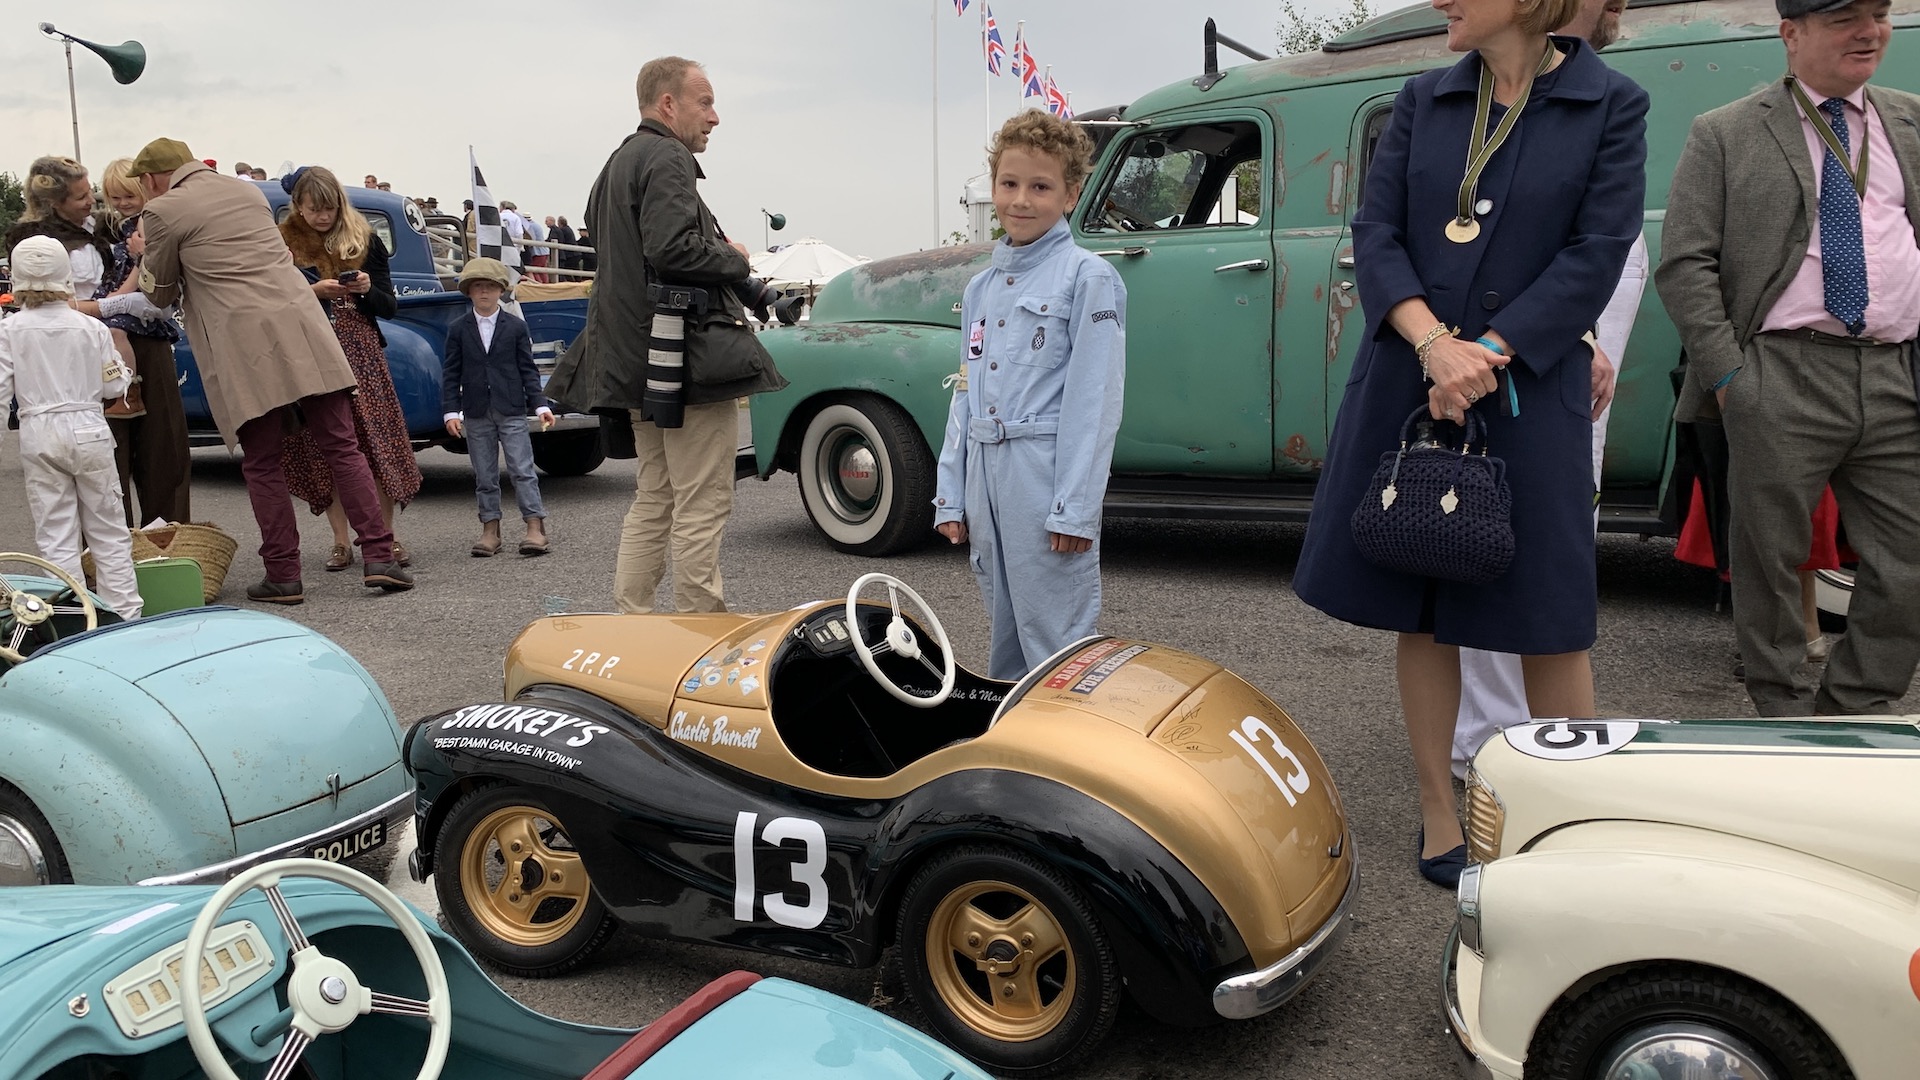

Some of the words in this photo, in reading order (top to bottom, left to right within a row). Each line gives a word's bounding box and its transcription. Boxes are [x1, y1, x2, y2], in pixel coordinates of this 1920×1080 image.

[406, 204, 423, 231] 3
[1054, 663, 1085, 681] DAN
[1074, 673, 1104, 692] FOR
[968, 688, 977, 700] &
[442, 704, 610, 747] SMOKEY'S
[671, 710, 710, 743] Charlie
[711, 715, 761, 750] Burnett
[1534, 723, 1610, 750] 5
[459, 737, 490, 749] DAMN
[489, 739, 534, 756] GARAGE
[532, 747, 547, 759] IN
[1228, 716, 1310, 808] 13
[314, 823, 381, 862] POLICE
[734, 811, 829, 930] 13
